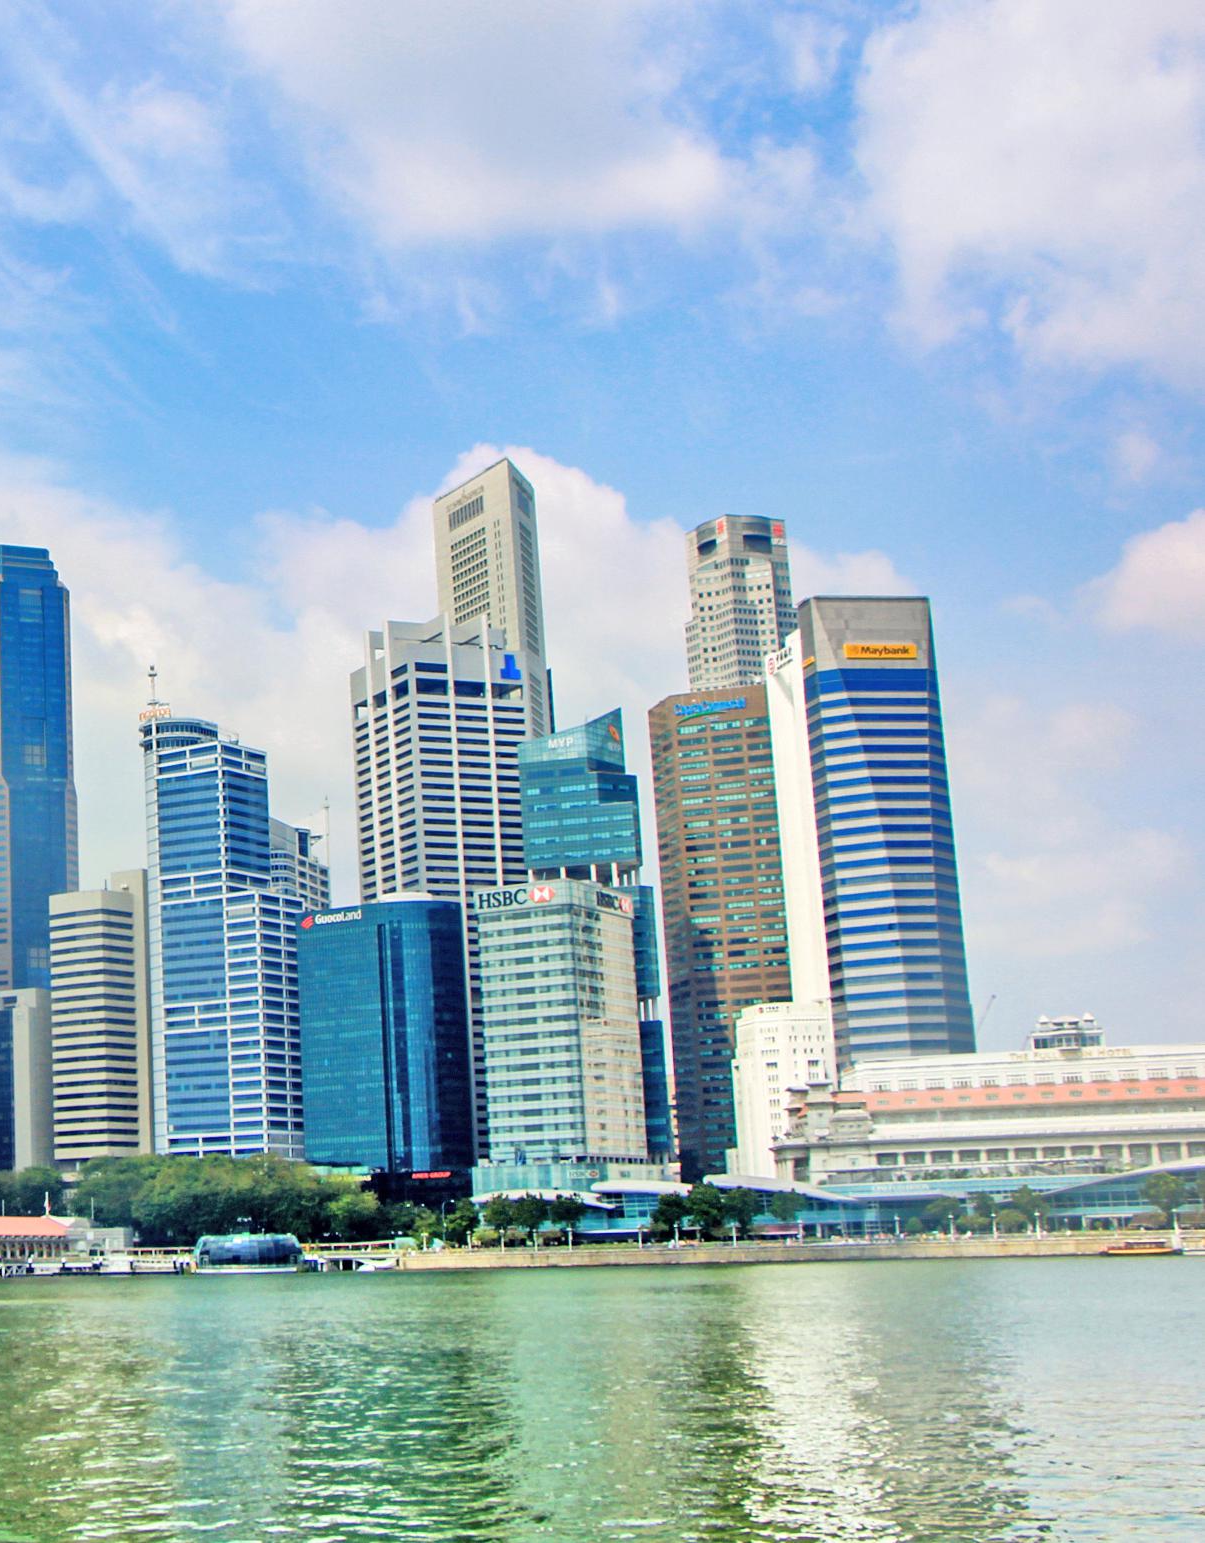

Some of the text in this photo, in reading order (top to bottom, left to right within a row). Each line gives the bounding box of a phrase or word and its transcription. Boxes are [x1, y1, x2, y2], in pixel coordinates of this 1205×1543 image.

[860, 645, 909, 656] Maybank
[548, 737, 573, 748] MYP
[479, 888, 527, 910] HSBC
[596, 890, 619, 910] HSBC
[315, 909, 362, 924] GuocoLand
